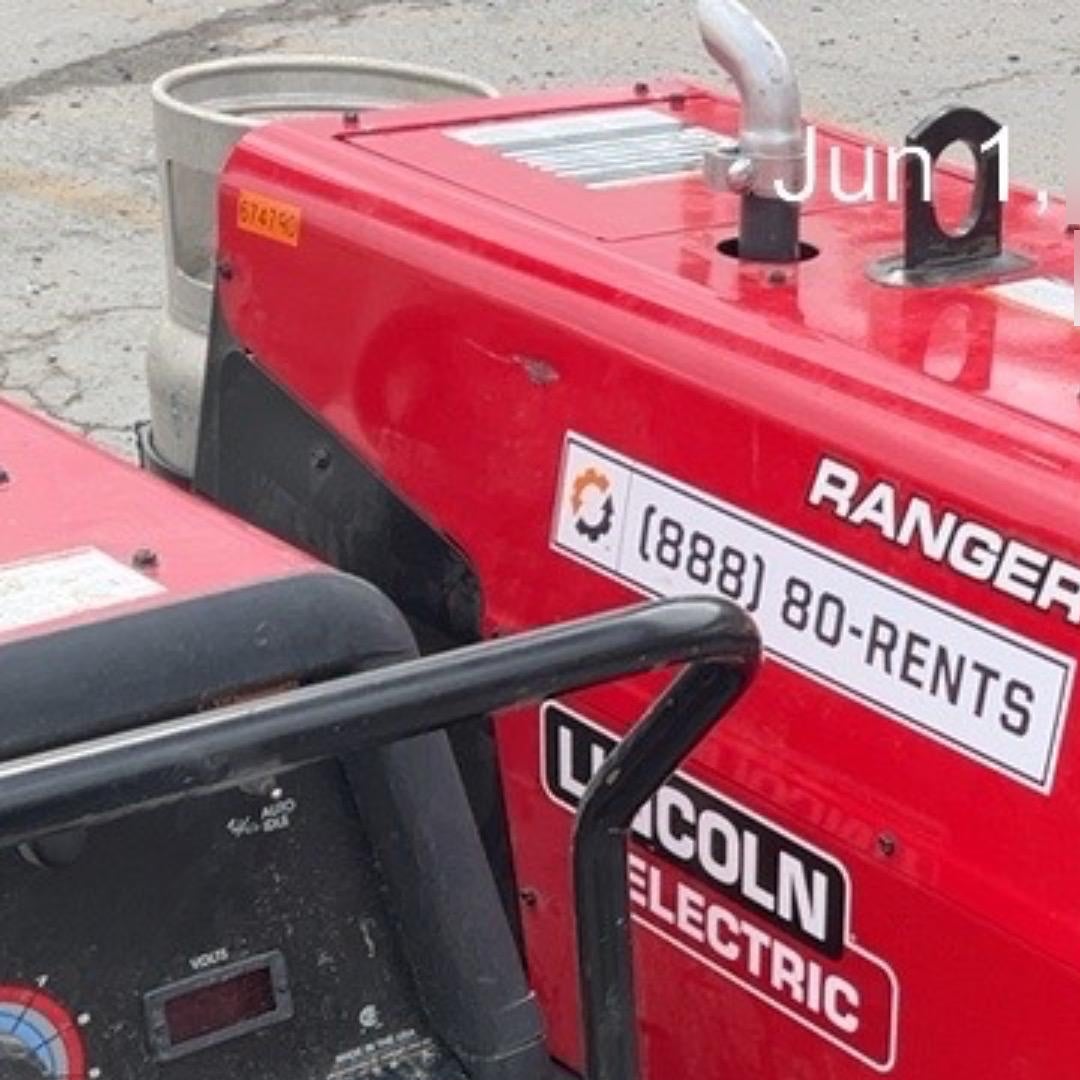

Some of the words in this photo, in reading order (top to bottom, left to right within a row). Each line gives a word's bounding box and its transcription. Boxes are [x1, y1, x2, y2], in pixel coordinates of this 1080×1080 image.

[638, 504, 766, 613] (888)
[780, 575, 1035, 737] 80-RENTS
[629, 853, 861, 1033] ELECTRIC
